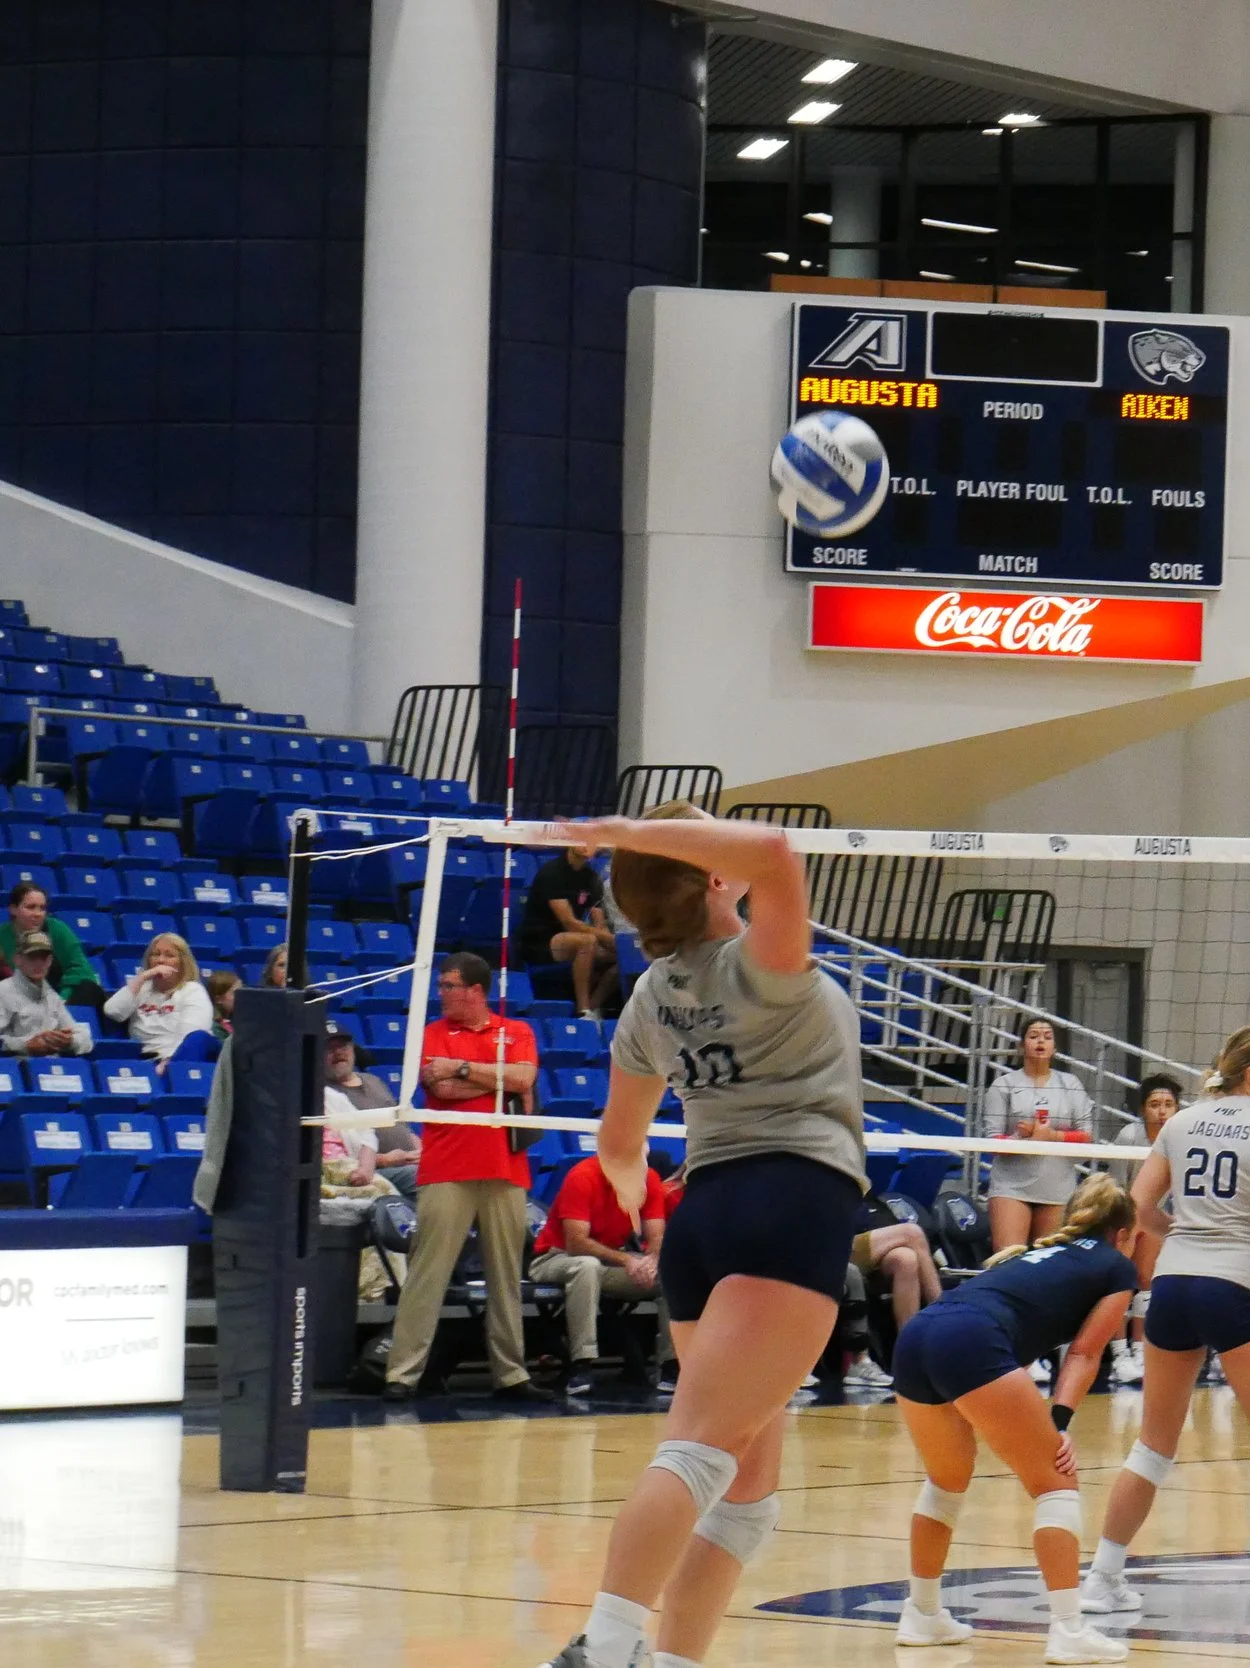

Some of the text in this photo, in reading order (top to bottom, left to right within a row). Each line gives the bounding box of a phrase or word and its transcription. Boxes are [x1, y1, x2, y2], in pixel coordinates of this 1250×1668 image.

[800, 377, 938, 408] AUGUSTA
[983, 401, 1044, 421] PERIOD
[1121, 393, 1189, 421] AIKEN
[890, 477, 937, 496] T.O.L.
[956, 480, 1069, 502] PLAYER FOUL
[1086, 486, 1133, 506] T.O.L.
[1151, 489, 1206, 508] FOULS
[812, 547, 868, 566] SCORE
[978, 554, 1038, 574] MATCH
[1149, 562, 1204, 582] SCORE
[914, 592, 1101, 656] Coca-Cola
[930, 833, 985, 851] AUGUSTA
[1134, 838, 1192, 856] AUGUSTA
[1183, 1147, 1239, 1199] 20
[291, 1287, 307, 1406] sports imports
